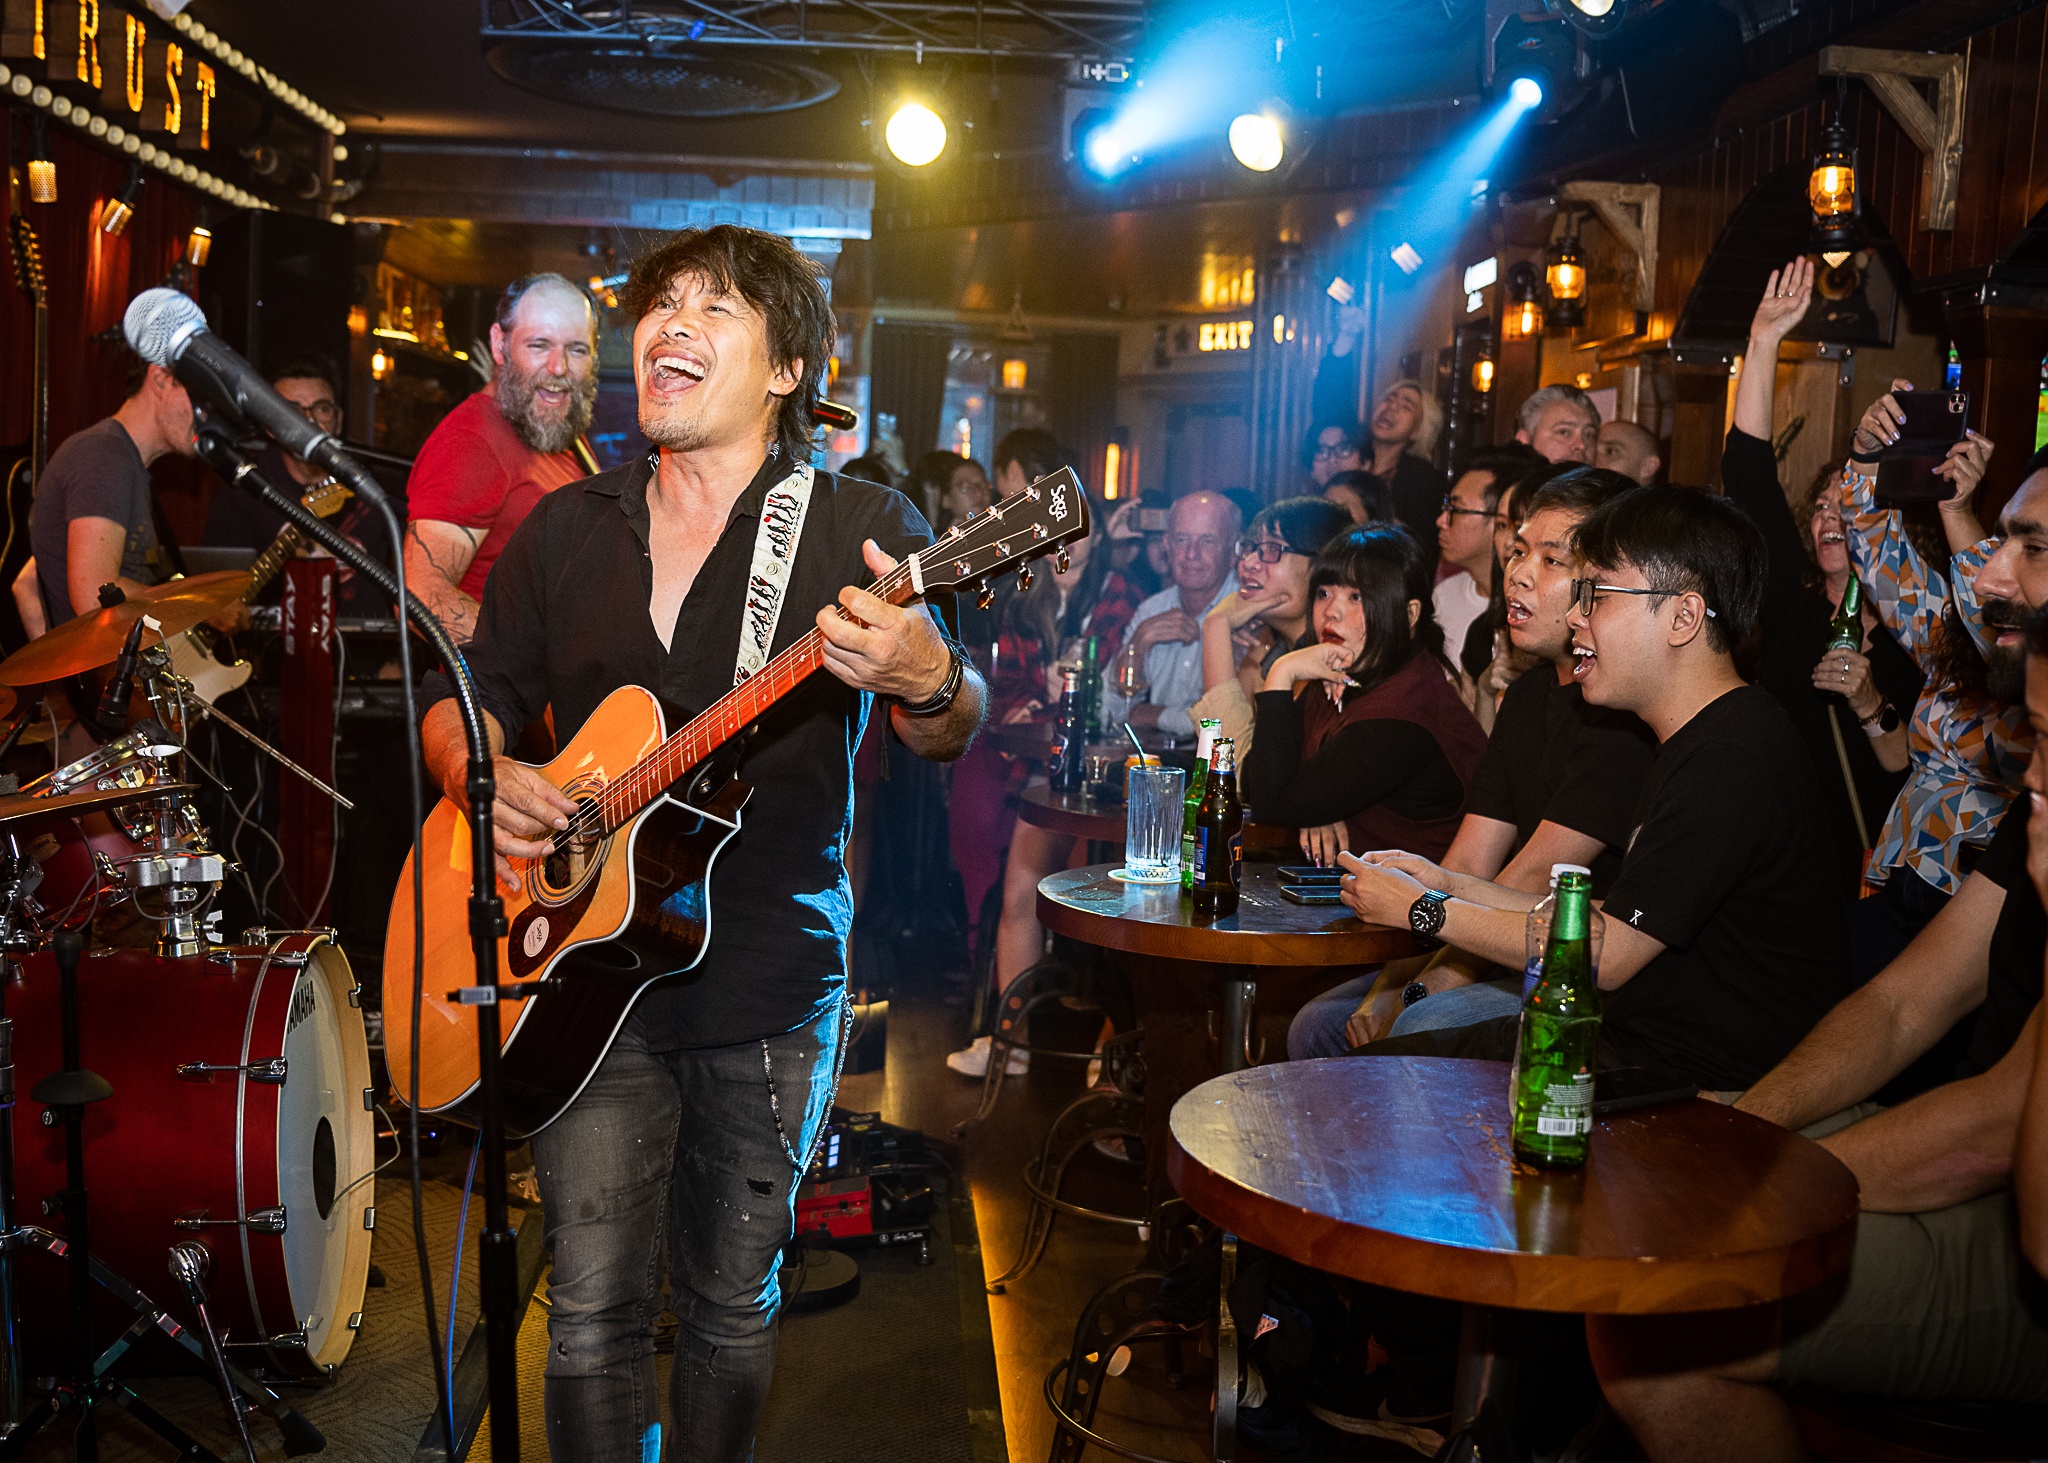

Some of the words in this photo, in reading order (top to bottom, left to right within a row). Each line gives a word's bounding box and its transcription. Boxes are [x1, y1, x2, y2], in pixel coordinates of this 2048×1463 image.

[1200, 321, 1254, 352] EXIT
[1048, 484, 1068, 522] Saga
[286, 573, 296, 655] STAY
[321, 574, 332, 653] STAY
[286, 980, 316, 1034] AMAHA
